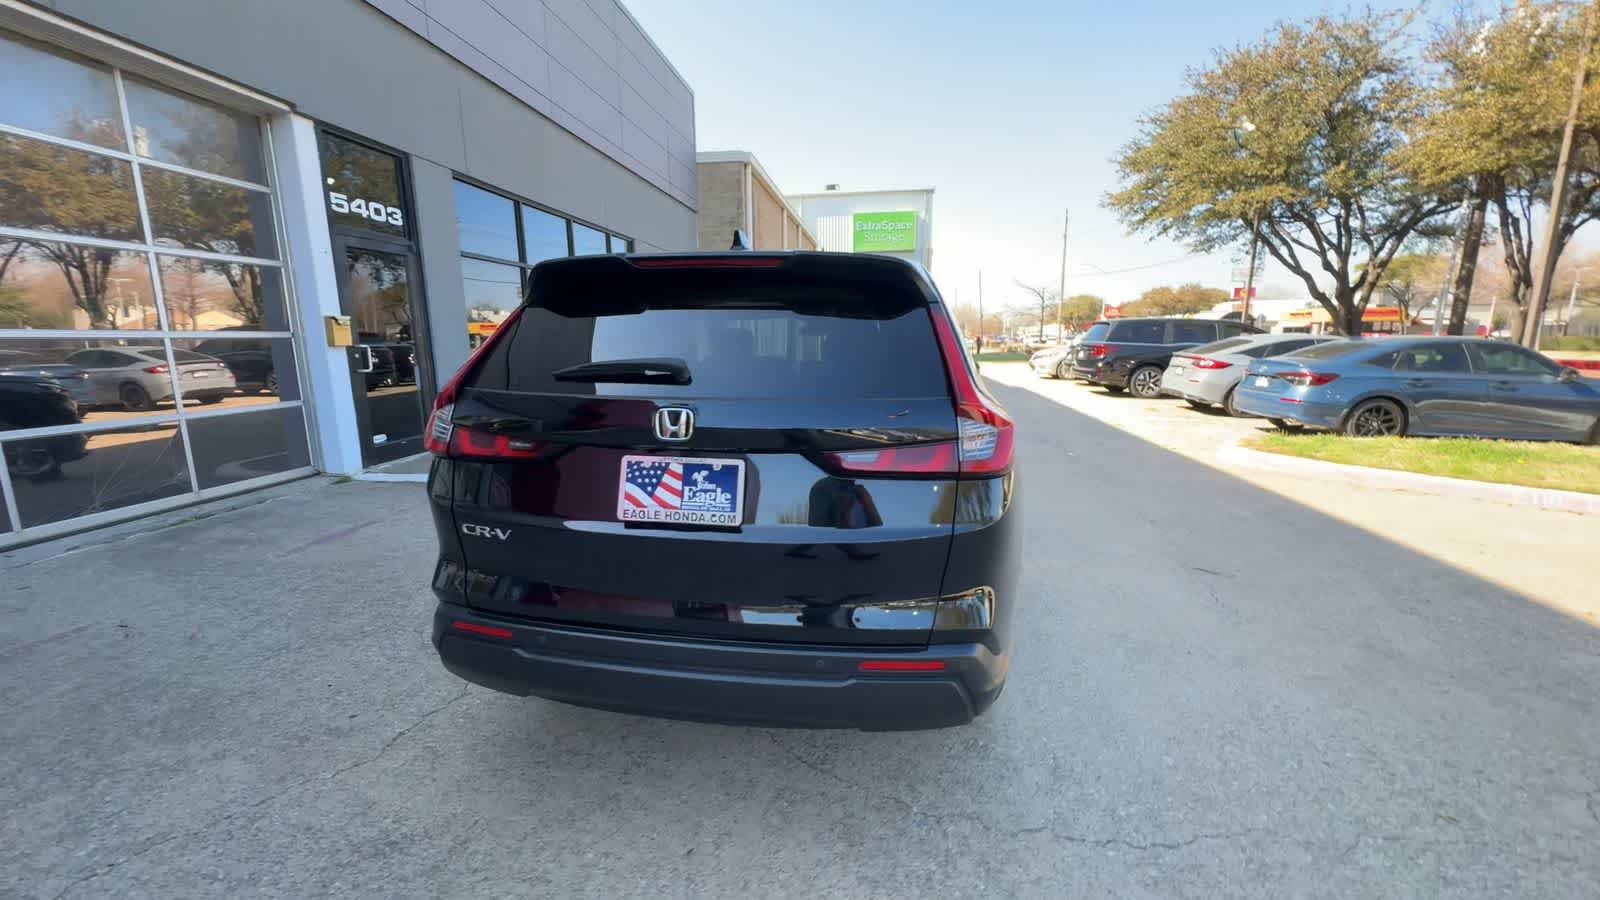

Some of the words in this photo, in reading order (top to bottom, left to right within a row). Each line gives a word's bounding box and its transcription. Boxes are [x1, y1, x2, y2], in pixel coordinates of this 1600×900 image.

[329, 191, 404, 226] 5403
[683, 486, 732, 507] Eagle
[623, 509, 661, 520] EAGLE
[462, 523, 512, 540] CR-V
